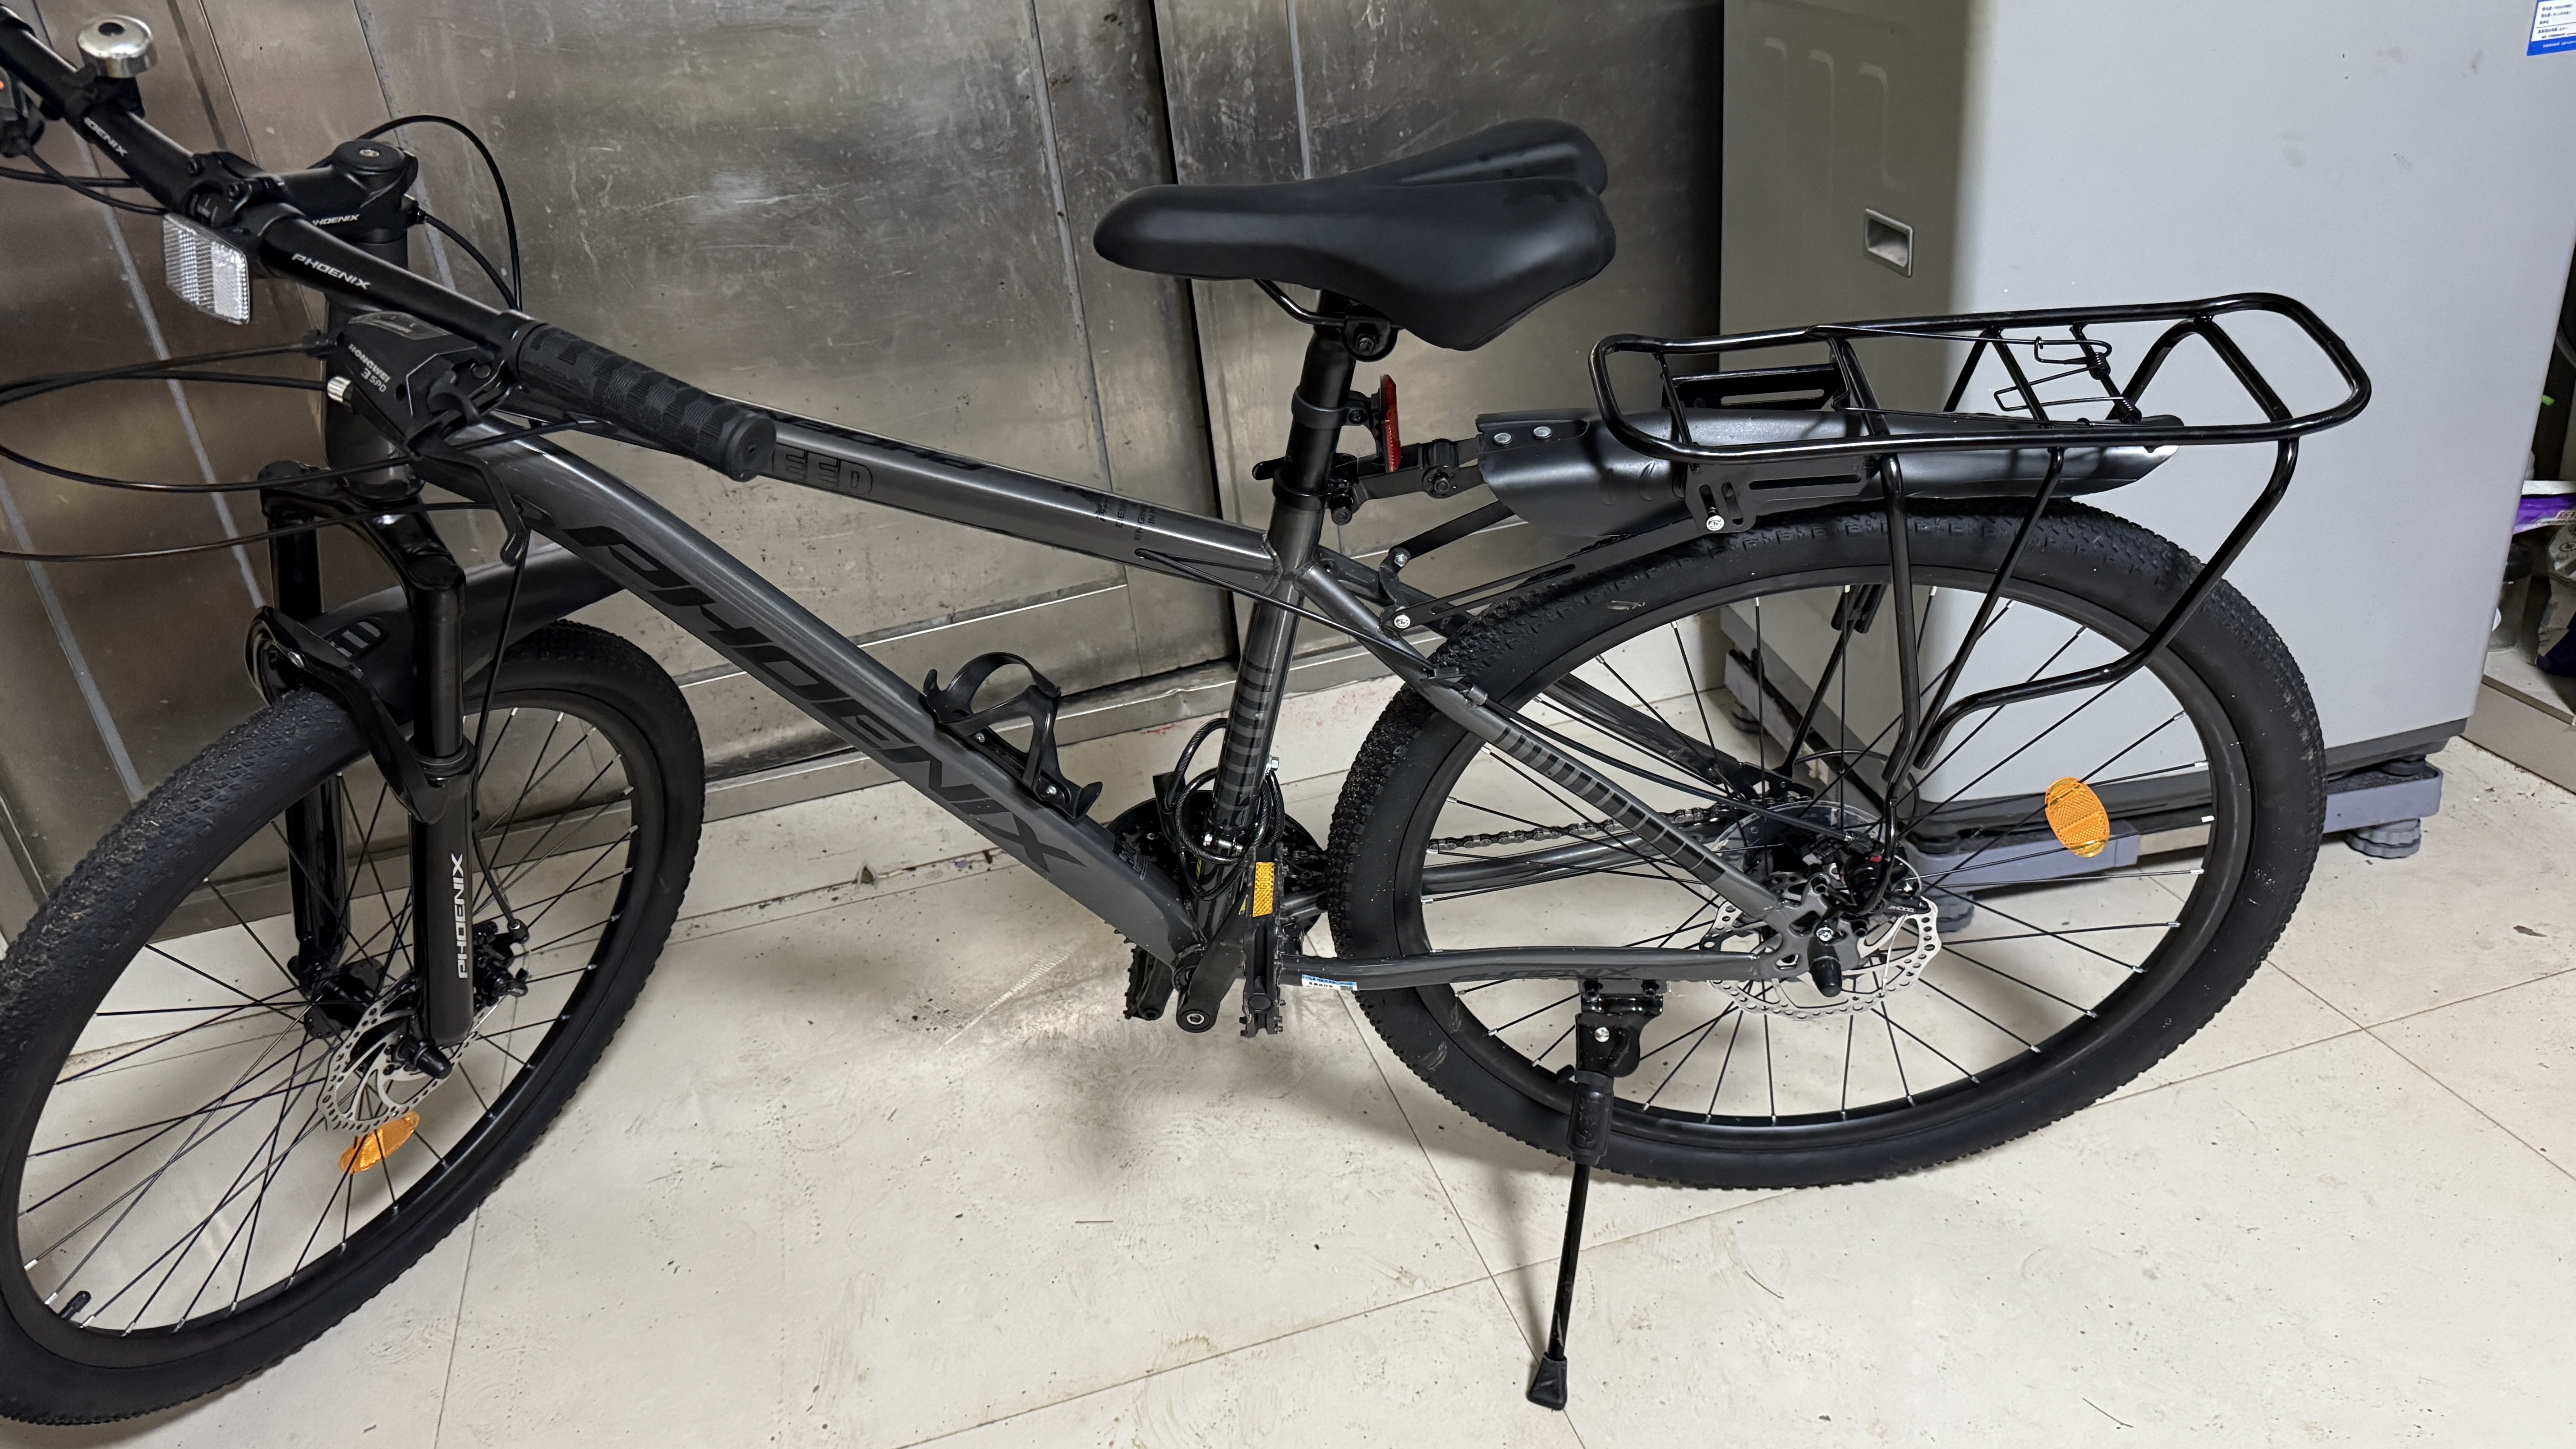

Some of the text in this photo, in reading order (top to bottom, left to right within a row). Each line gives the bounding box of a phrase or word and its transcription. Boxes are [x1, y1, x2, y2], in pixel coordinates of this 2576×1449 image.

[83, 117, 128, 157] OENIX
[312, 214, 360, 225] HOENIX
[291, 253, 371, 290] PHOENIX
[348, 344, 391, 383] HONGWEI
[772, 442, 873, 495] EED
[562, 526, 1089, 873] PHOENIX
[451, 853, 468, 978] PHOENIX
